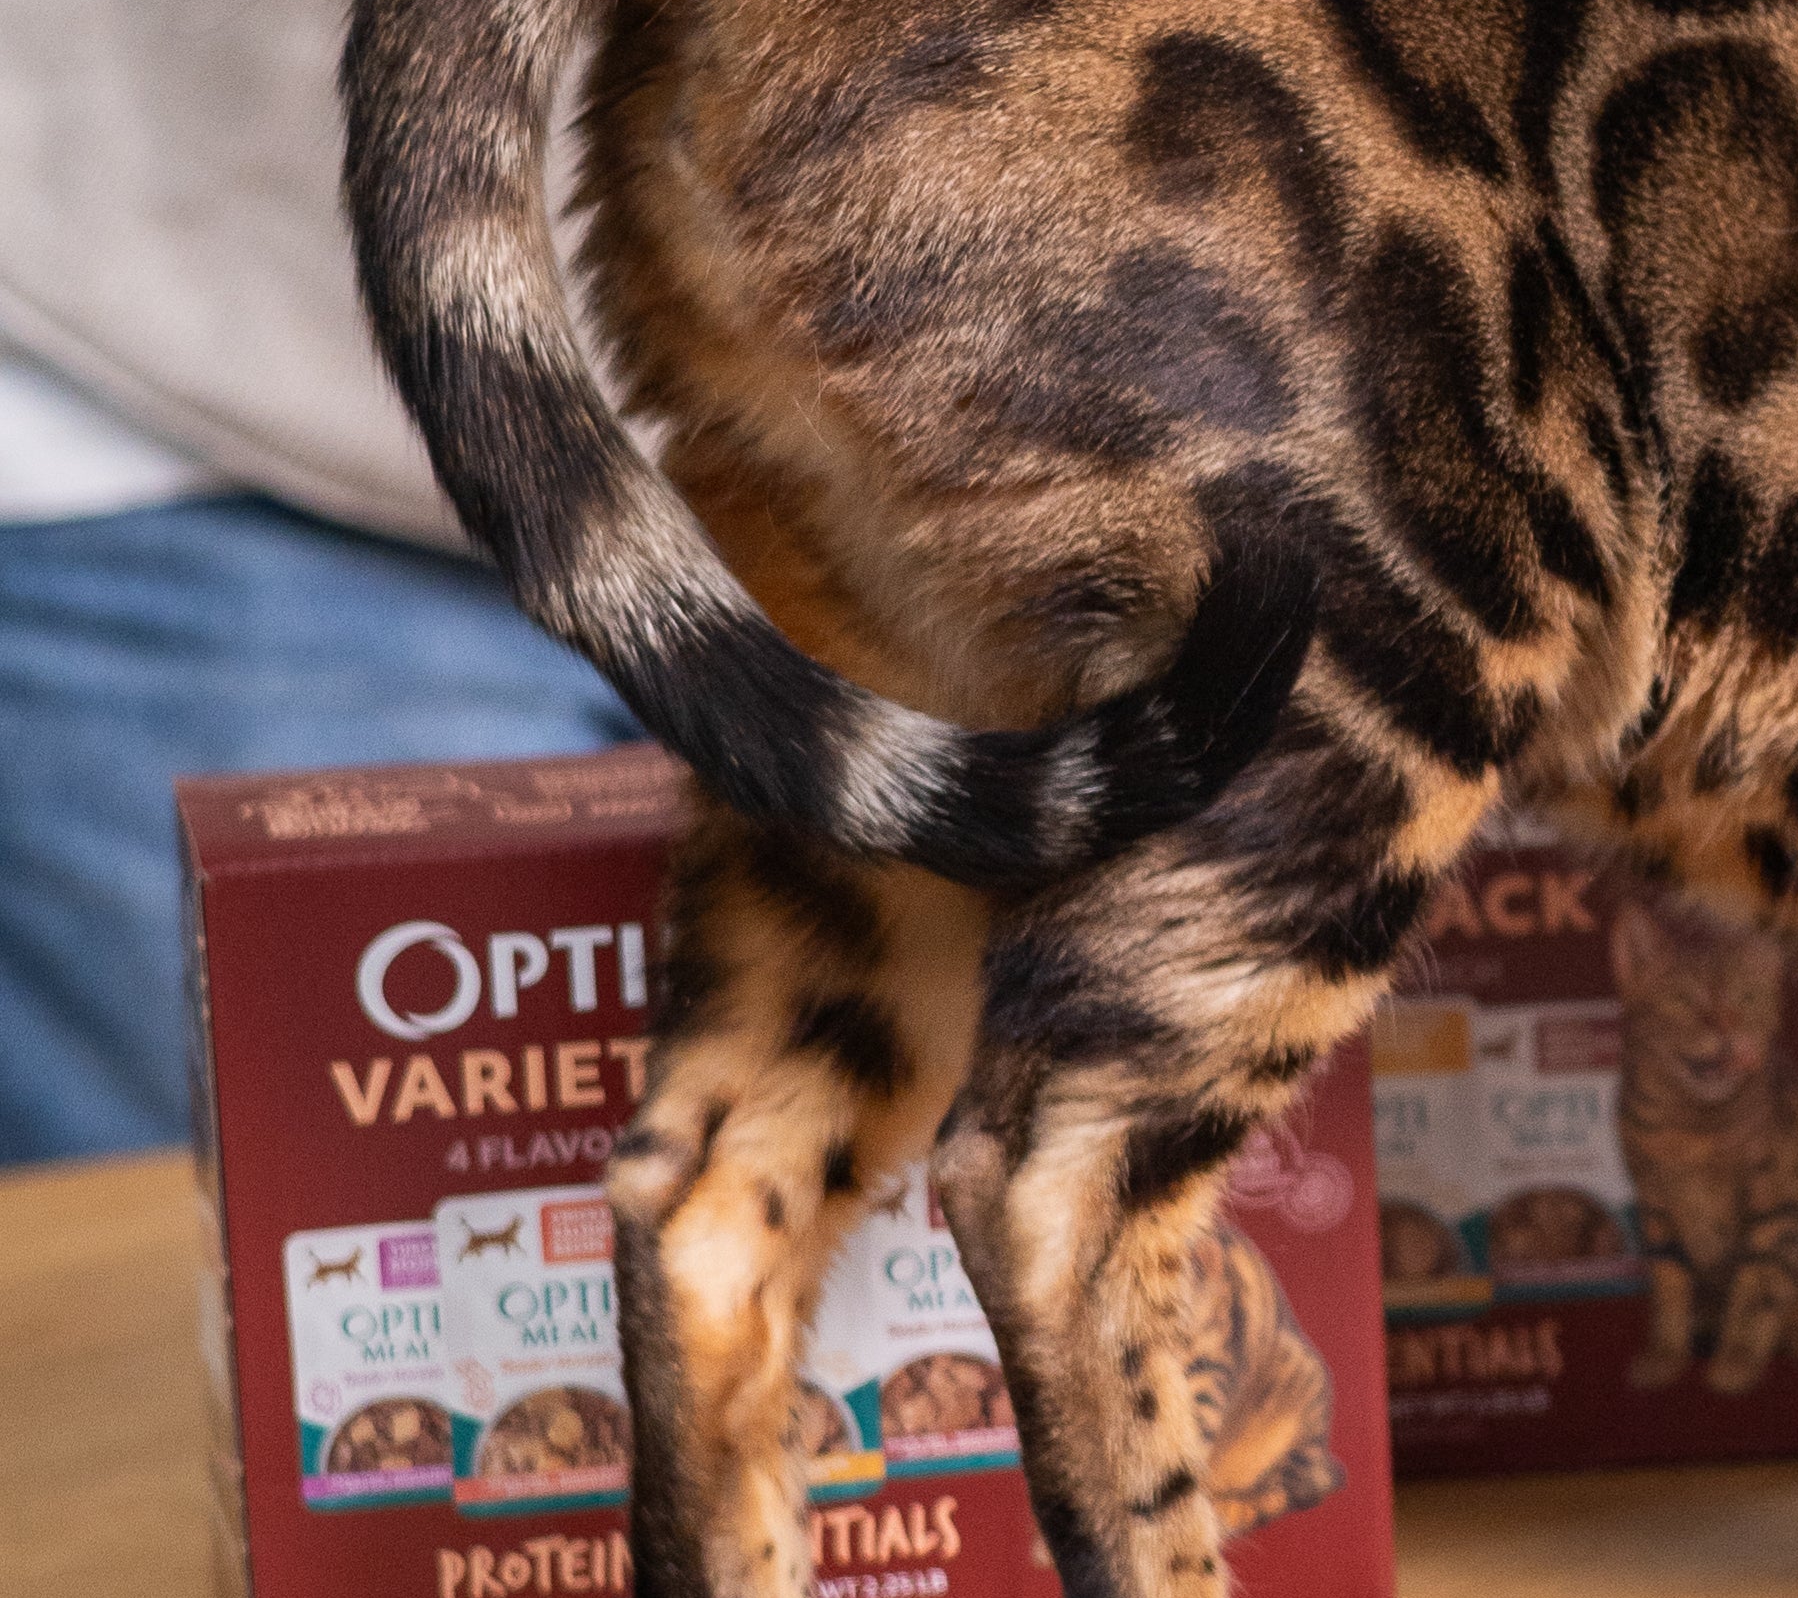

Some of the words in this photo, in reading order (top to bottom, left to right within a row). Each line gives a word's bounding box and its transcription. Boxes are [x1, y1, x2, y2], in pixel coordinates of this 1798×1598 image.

[1426, 869, 1597, 939] ACK
[356, 920, 648, 1041] OPTI
[330, 1037, 653, 1126] VARIET
[477, 1127, 620, 1171] FLAVO
